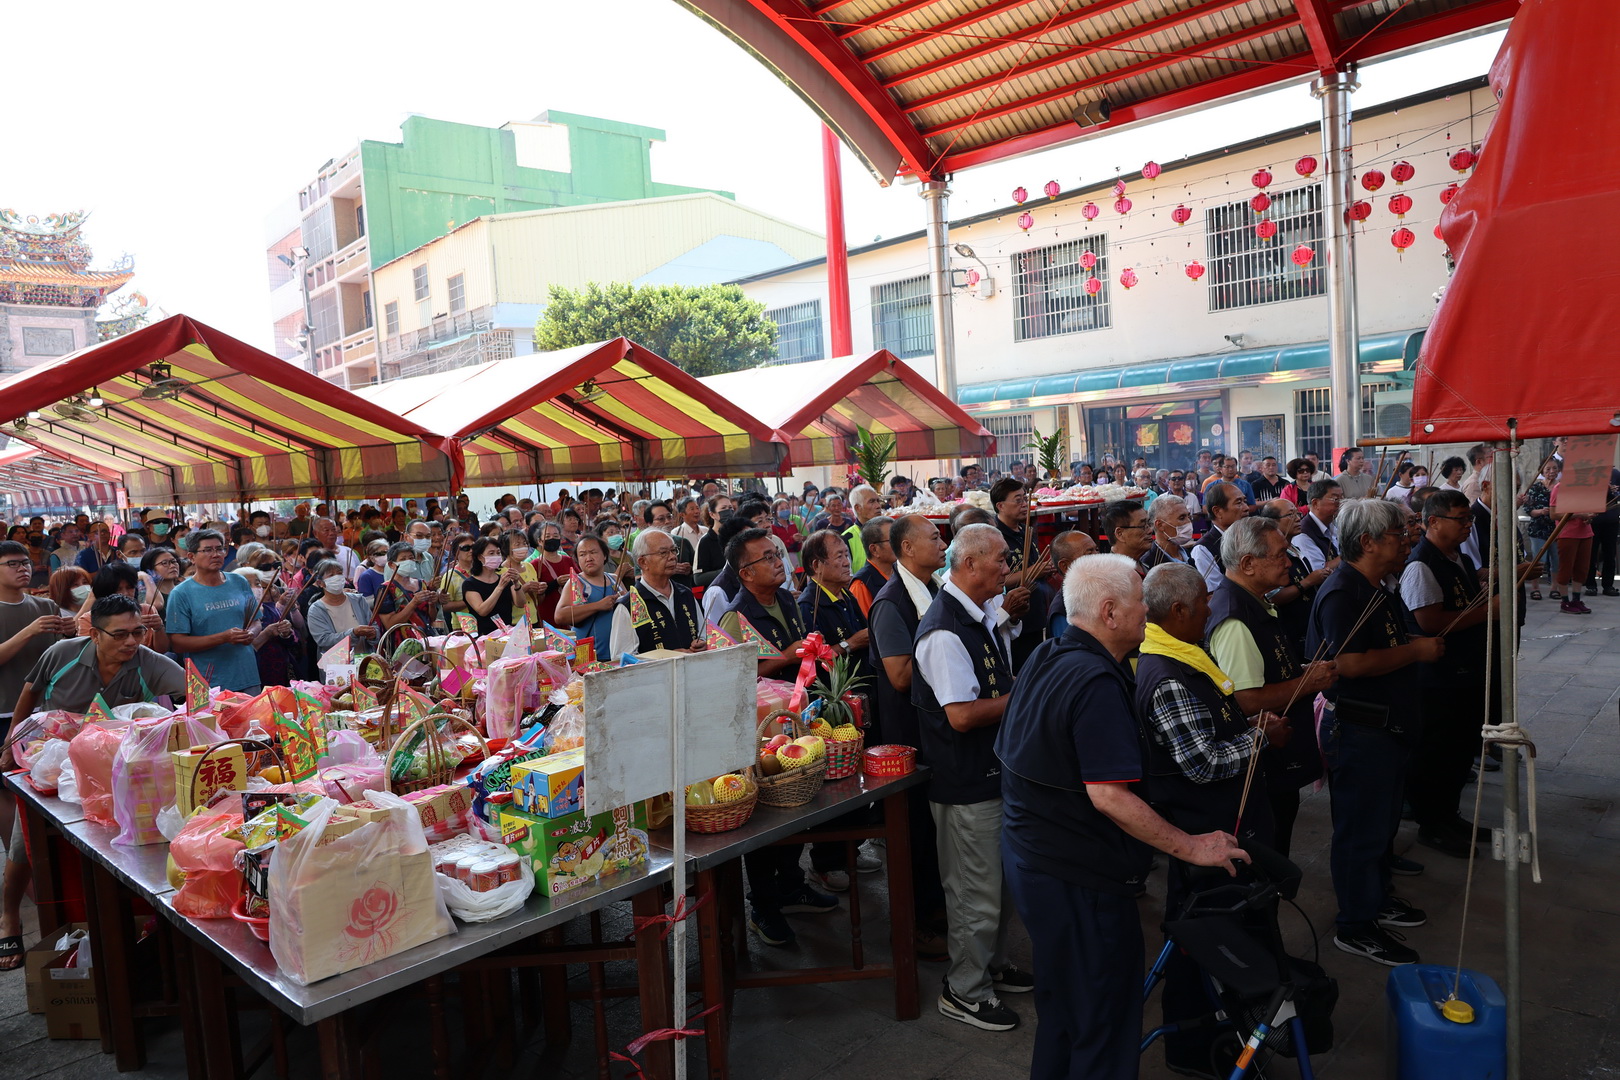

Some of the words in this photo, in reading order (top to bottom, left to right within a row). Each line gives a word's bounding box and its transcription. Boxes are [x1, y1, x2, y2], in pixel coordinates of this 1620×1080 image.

[205, 599, 240, 611] FASHION
[199, 757, 236, 787] 福
[553, 882, 559, 893] 6
